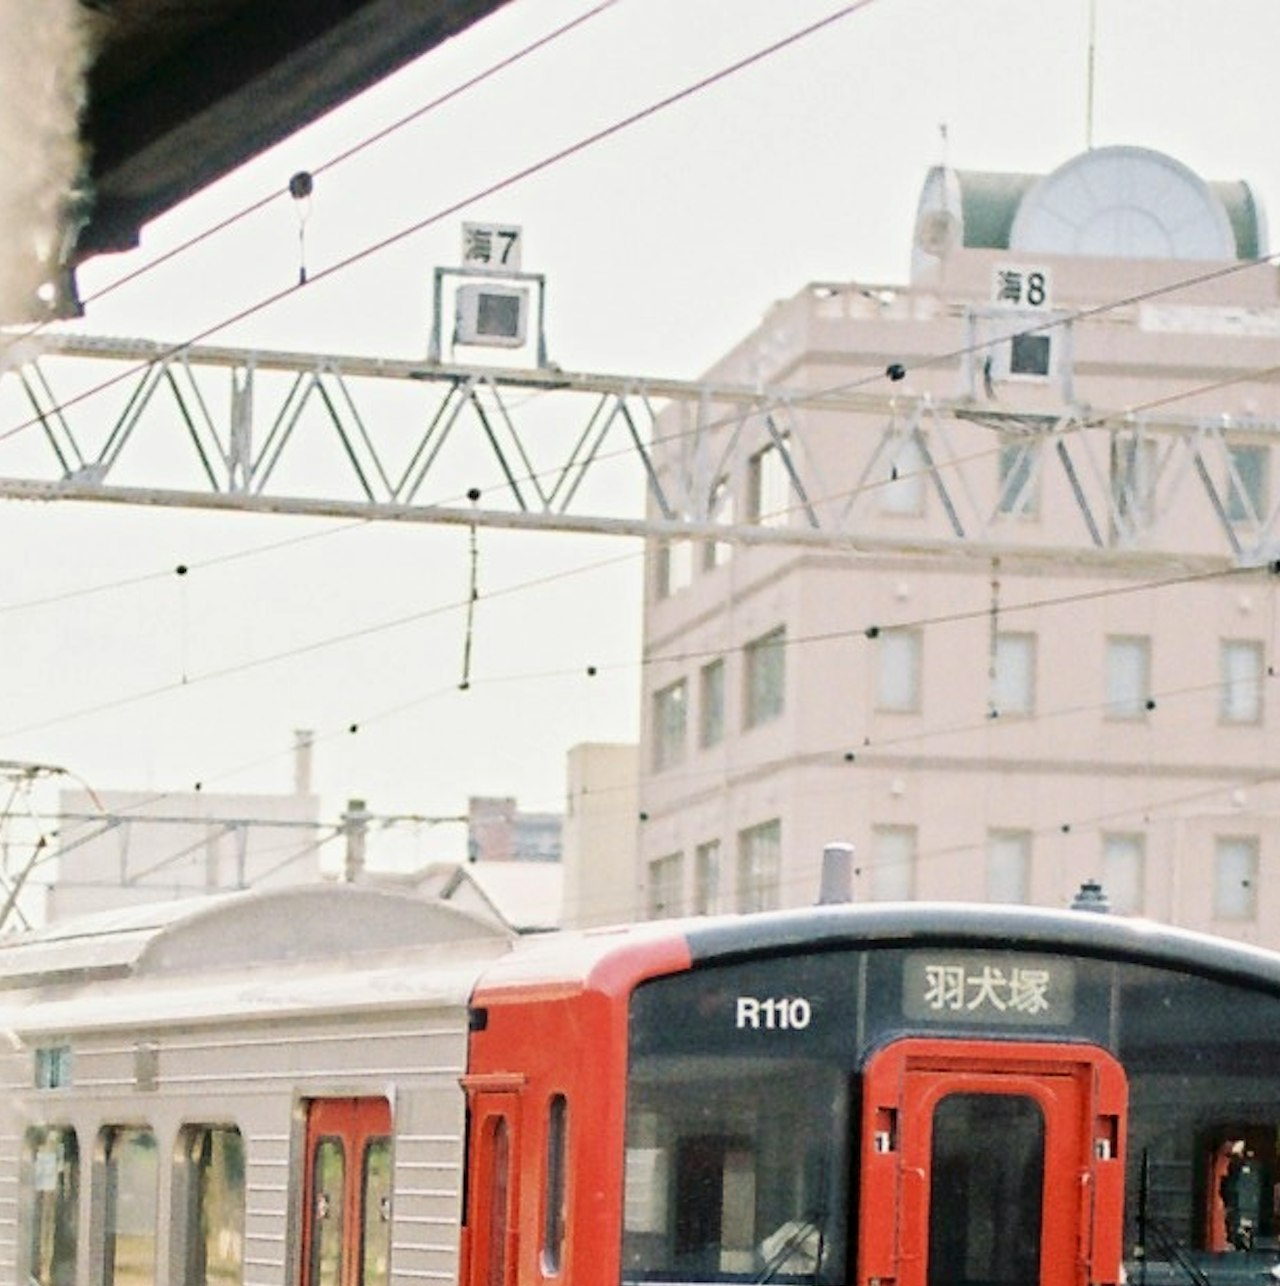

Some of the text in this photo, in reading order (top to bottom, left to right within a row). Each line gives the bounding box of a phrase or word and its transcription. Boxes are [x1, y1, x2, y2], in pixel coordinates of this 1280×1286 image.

[923, 964, 1051, 1015] 羽犬塚
[735, 996, 812, 1030] R110
